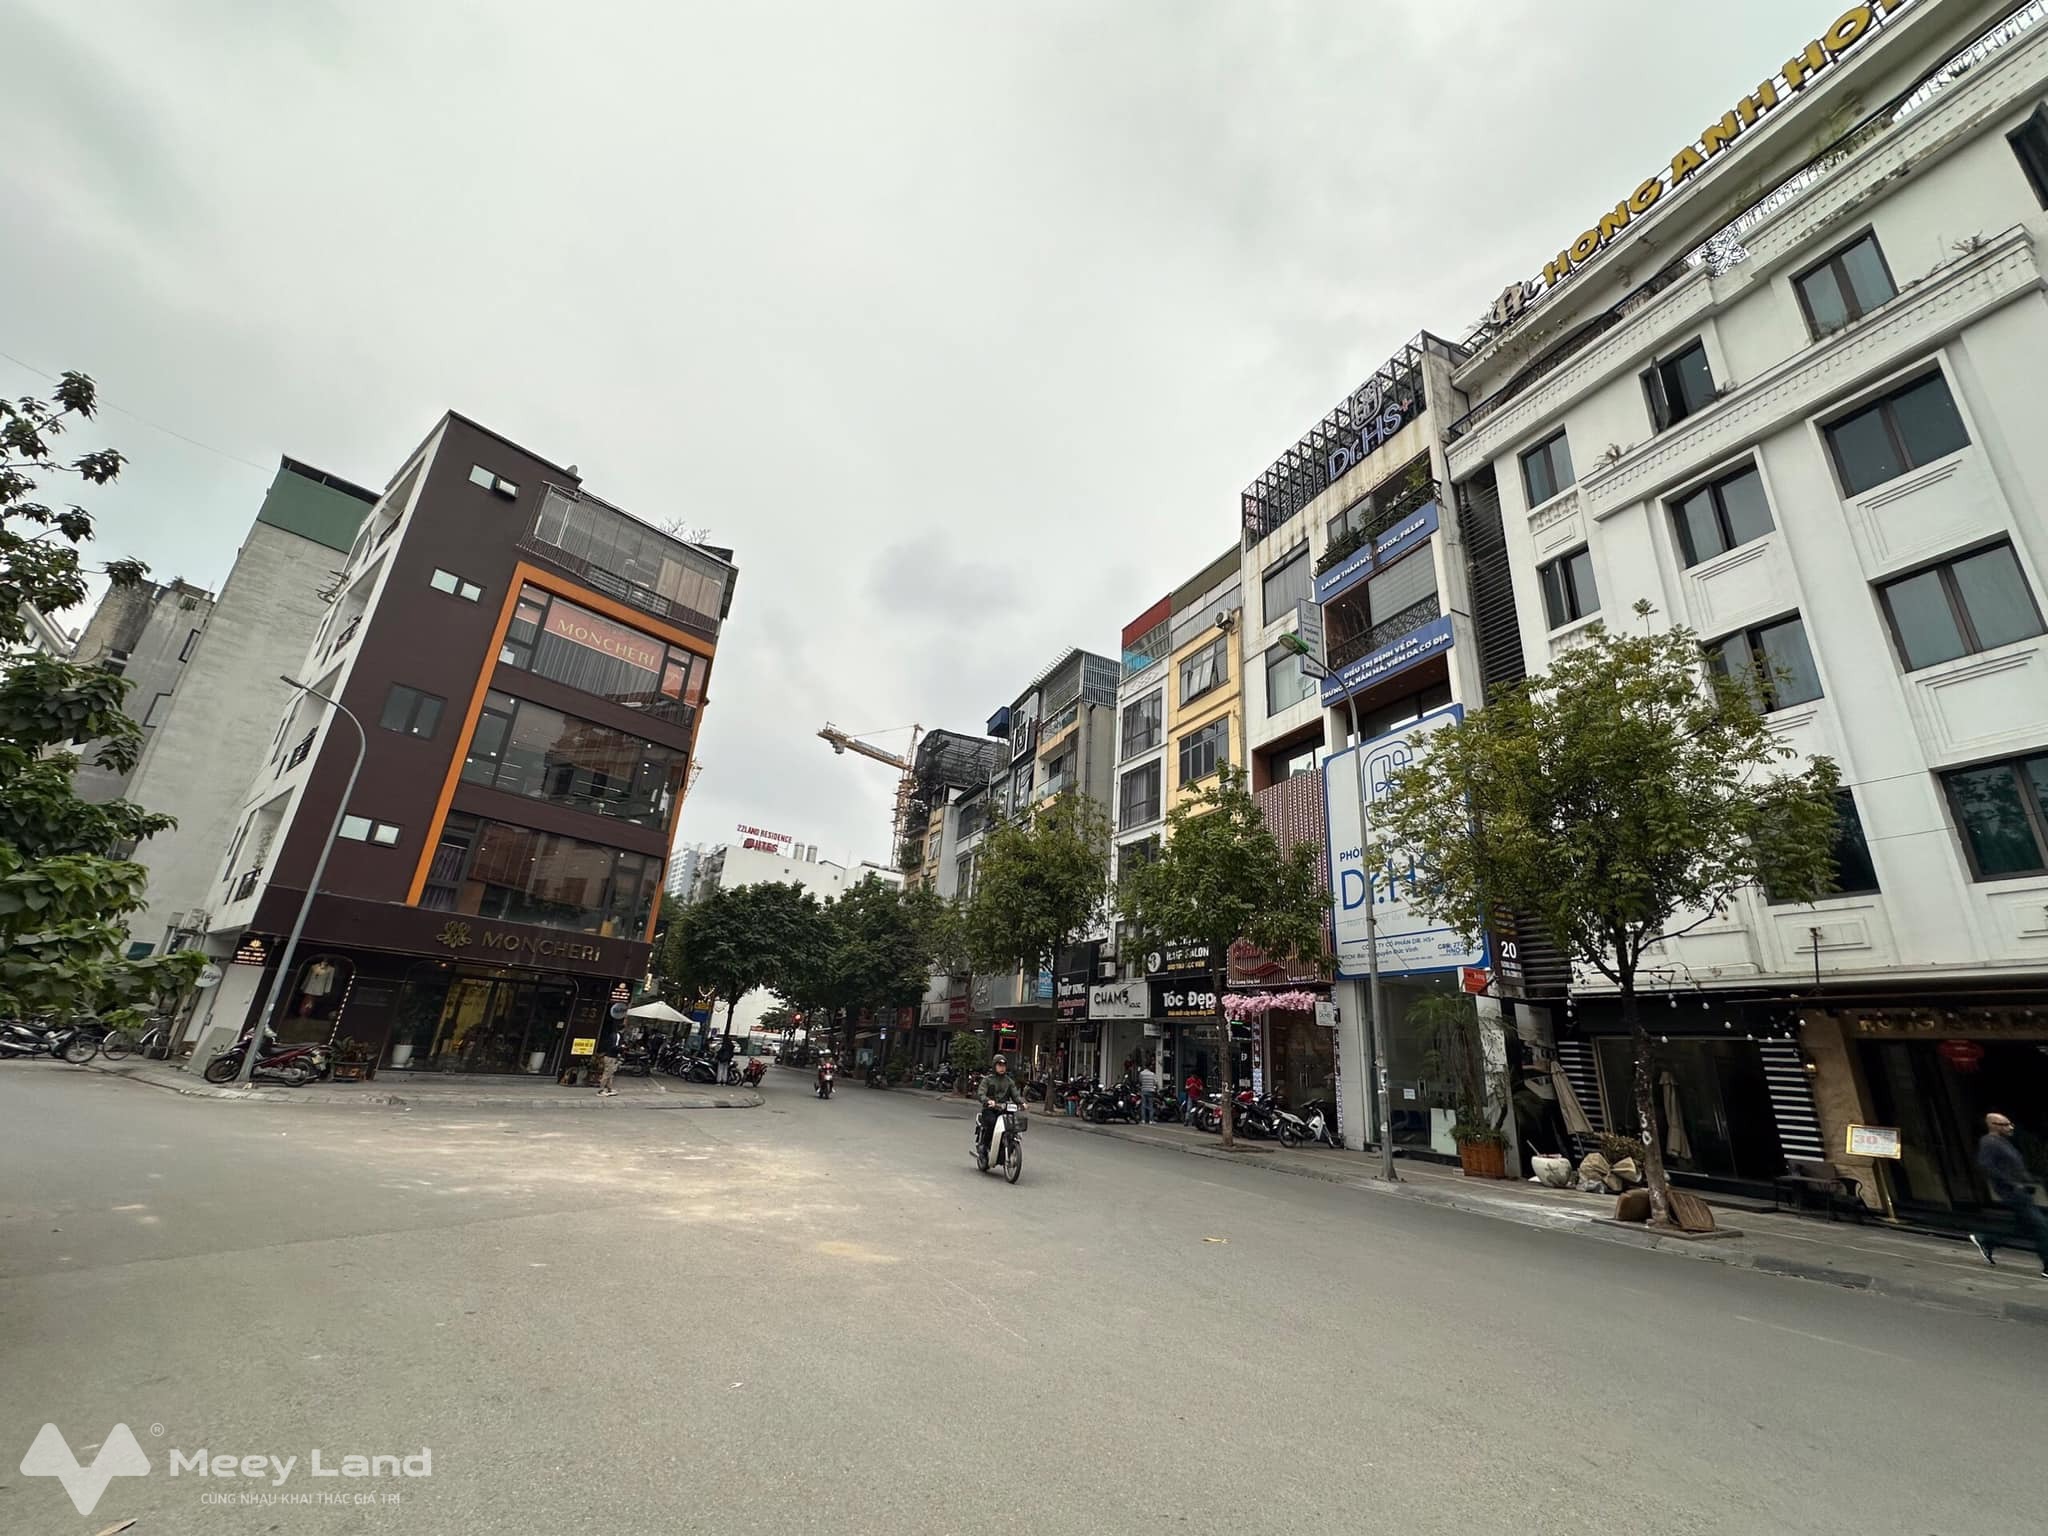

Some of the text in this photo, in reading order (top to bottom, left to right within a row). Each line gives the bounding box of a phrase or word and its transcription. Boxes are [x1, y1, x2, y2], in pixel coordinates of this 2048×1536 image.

[1670, 79, 1778, 187] ANH
[1782, 0, 1906, 92] HO
[558, 618, 655, 668] MONCHERI
[481, 930, 600, 962] MONCHERI
[1500, 940, 1518, 959] 20
[1162, 989, 1217, 1010] Tóc Đẹp
